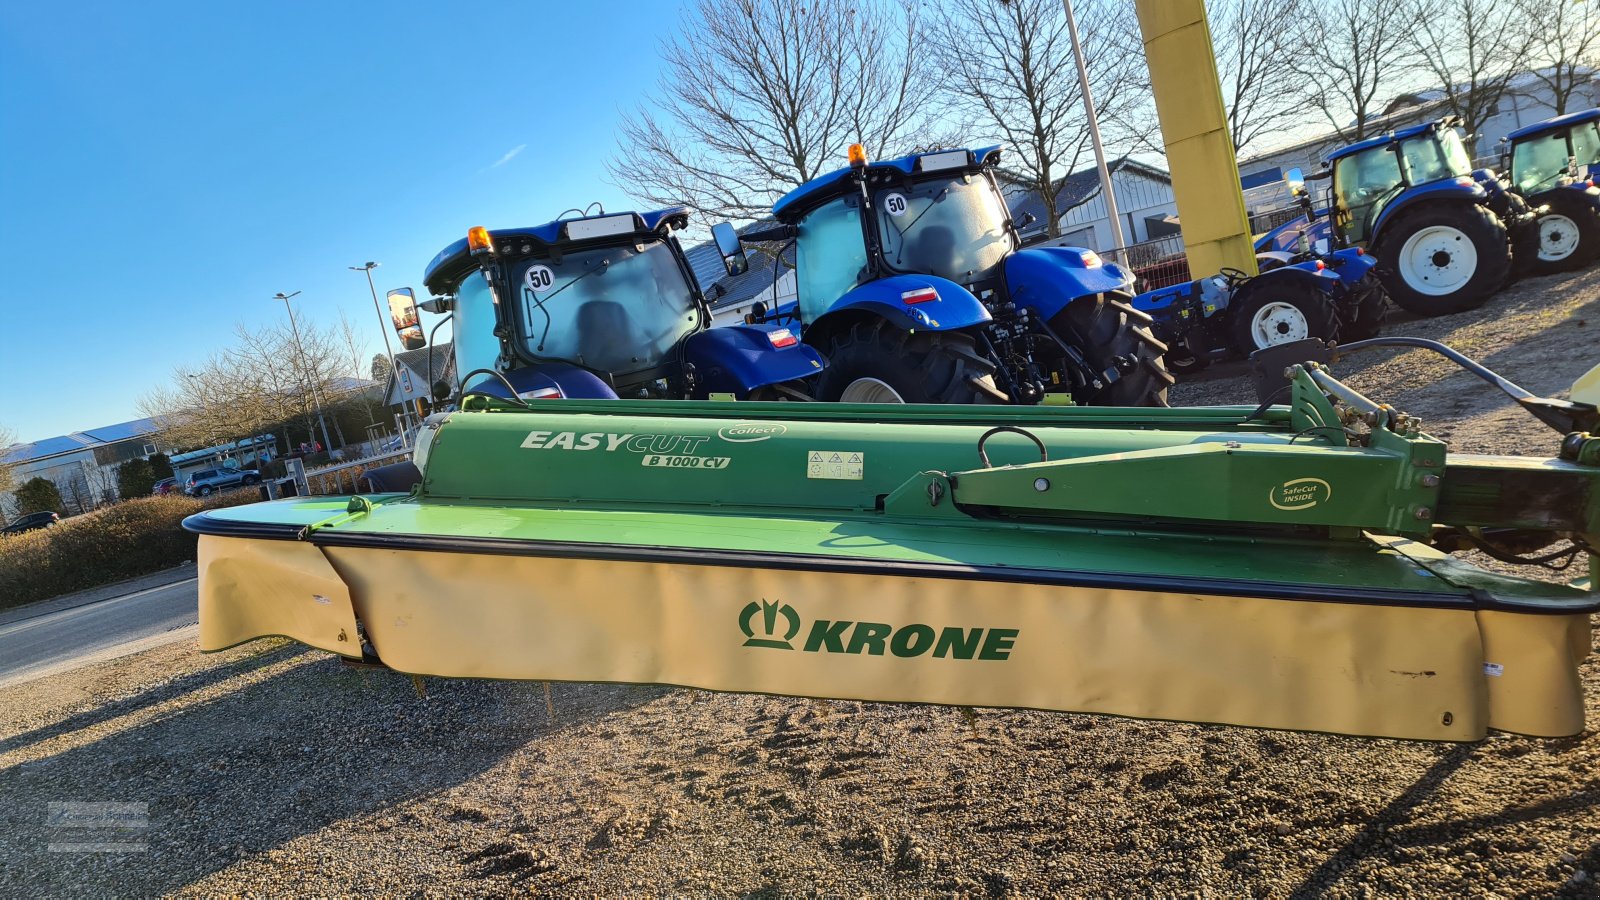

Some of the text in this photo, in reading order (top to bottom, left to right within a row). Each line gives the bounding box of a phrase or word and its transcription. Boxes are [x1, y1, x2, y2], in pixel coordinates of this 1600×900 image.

[888, 197, 905, 212] 50
[529, 269, 551, 288] 50
[728, 427, 777, 435] Collect
[520, 430, 710, 454] EASYCUT
[648, 456, 726, 468] B 1000 CV
[1283, 485, 1318, 495] SafeCut
[1284, 493, 1313, 502] INSIDE
[803, 619, 1020, 661] KRONE
